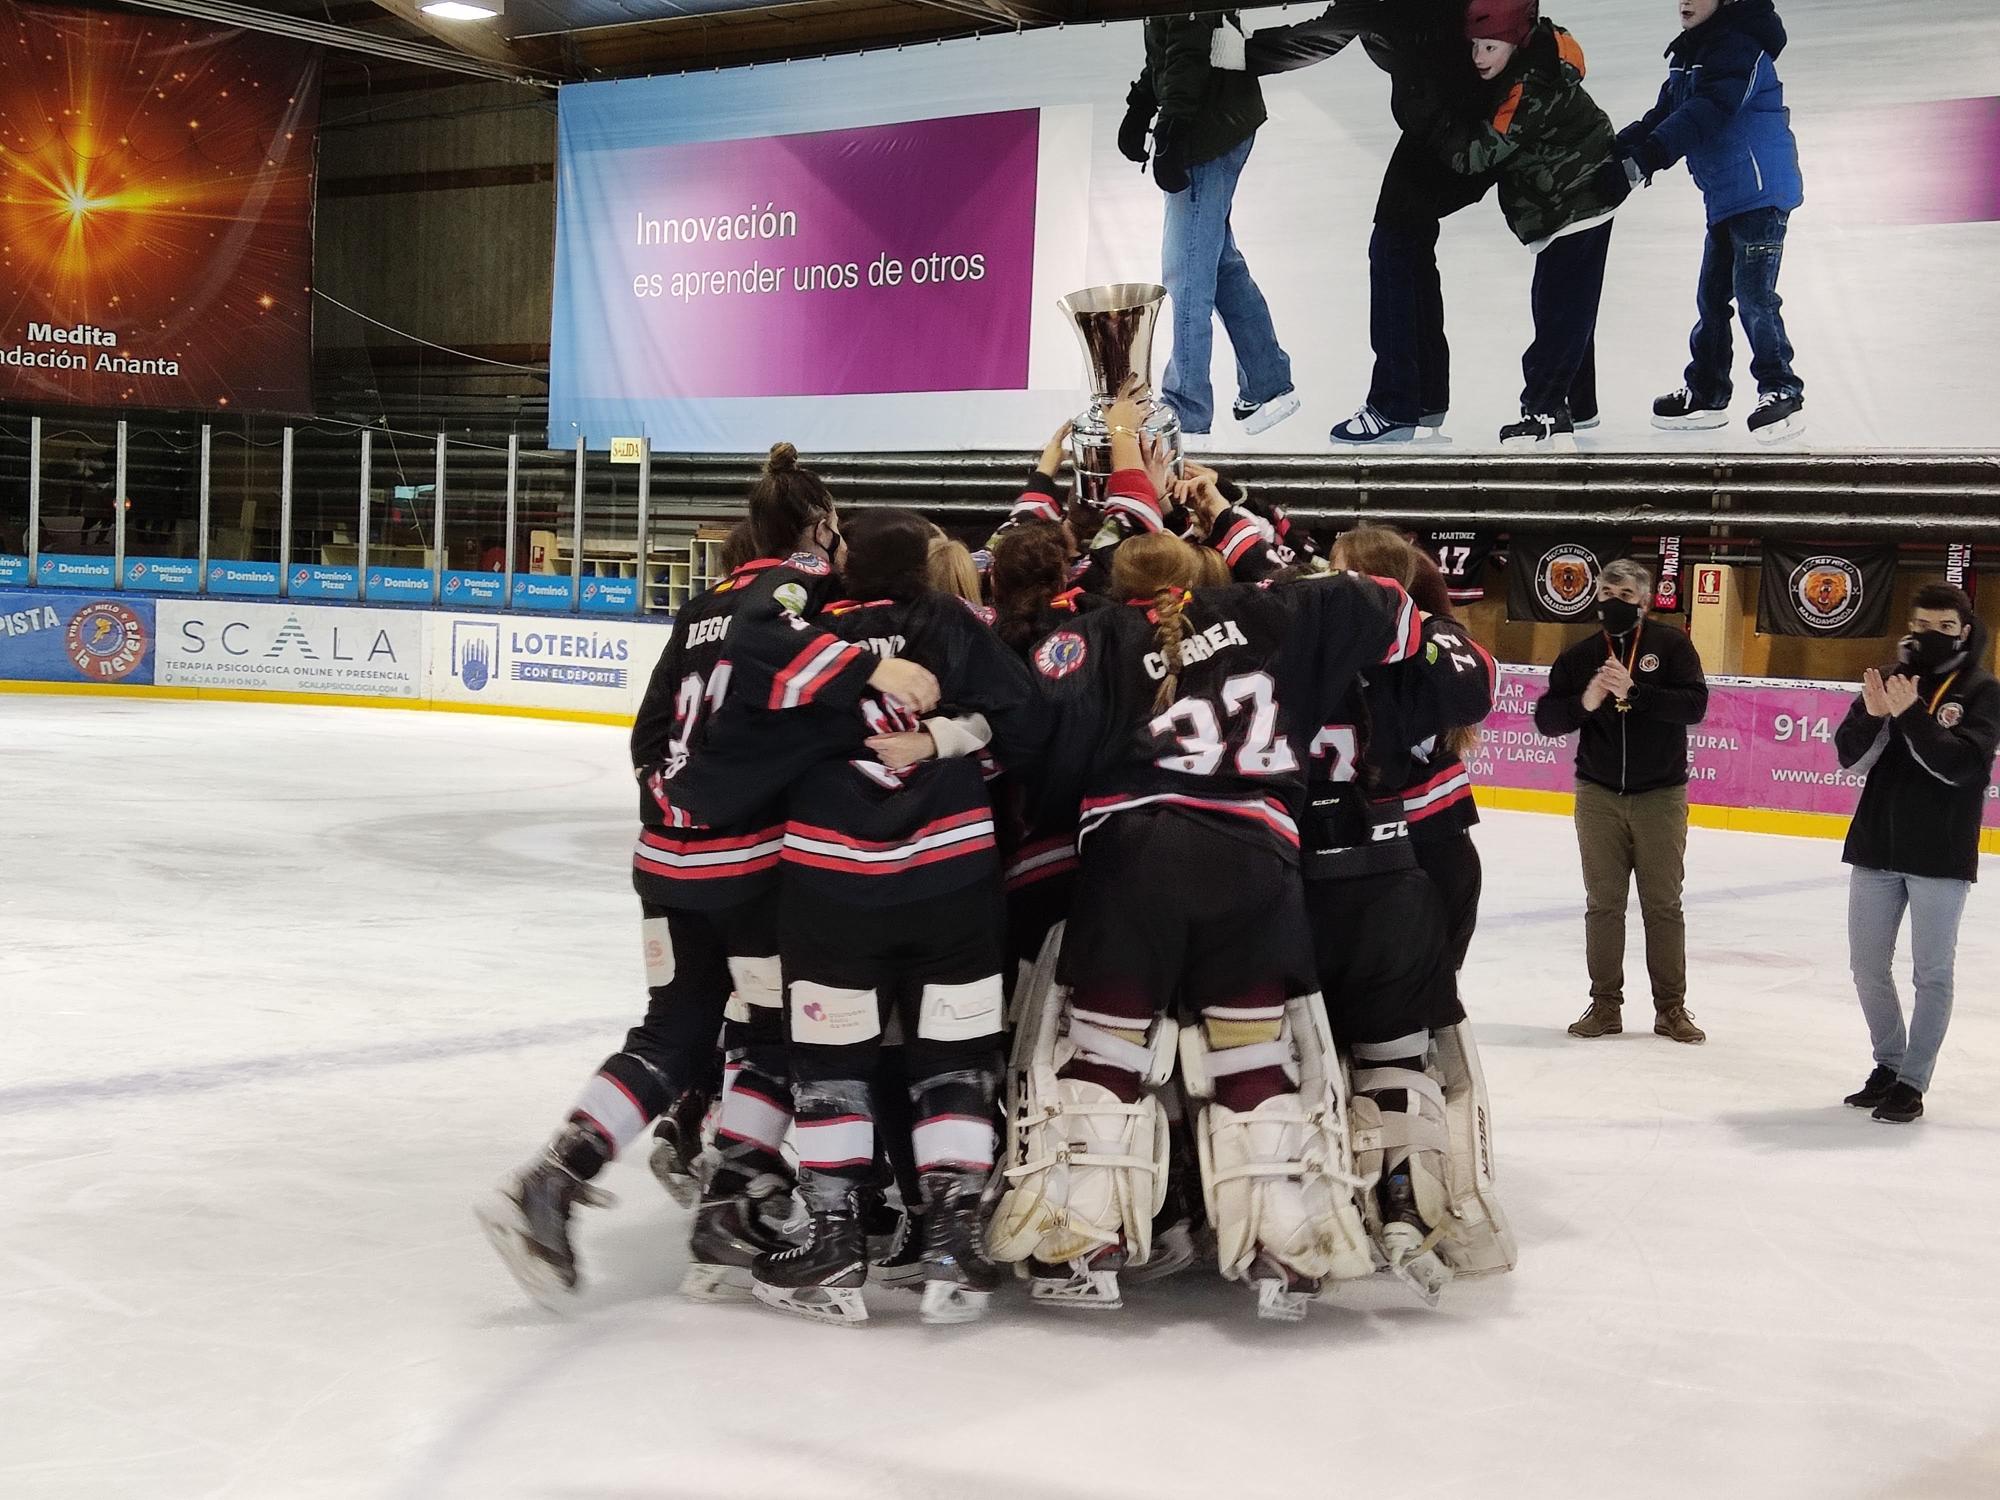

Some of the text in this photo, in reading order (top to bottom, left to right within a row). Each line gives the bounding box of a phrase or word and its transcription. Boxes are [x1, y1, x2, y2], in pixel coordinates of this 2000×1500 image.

[636, 203, 796, 245] Innovación
[633, 252, 985, 304] es aprender unos de otros
[27, 322, 117, 347] Medita
[94, 352, 179, 376] Ananta
[0, 557, 22, 567] ino's
[1439, 546, 1471, 575] 17
[1662, 536, 1680, 576] MAJAD
[59, 563, 110, 575] Domino's
[151, 563, 192, 576] Domino's
[226, 570, 275, 583] Domino's
[314, 571, 352, 582] Domino's
[160, 574, 184, 583] Pizza
[322, 581, 345, 590] Pizza
[384, 577, 429, 590] Domino's
[464, 578, 500, 590] Domino's
[471, 588, 493, 598] Pizza
[528, 584, 569, 597] Domino's
[600, 584, 632, 596] Domino's
[1798, 606, 1853, 625] MAJADAHONDA
[181, 612, 398, 664] SCALA
[74, 621, 141, 675] la nevera
[511, 632, 628, 661] LOTERÍAS
[166, 661, 410, 681] TERAPIA PSICOLÓGICA ONLINE Y PRESENCIAL
[524, 667, 616, 683] CON EL DEPORTE
[1148, 671, 1300, 776] 32
[1774, 714, 1831, 743] 914
[1481, 730, 1567, 748] DE IDIOMAS
[1686, 735, 1739, 750] TURAL
[1494, 747, 1504, 759] Y
[1508, 748, 1557, 764] LARGA
[1685, 766, 1716, 780] AIR
[1771, 768, 1867, 787] www.ef.co
[1312, 798, 1340, 806] CCM
